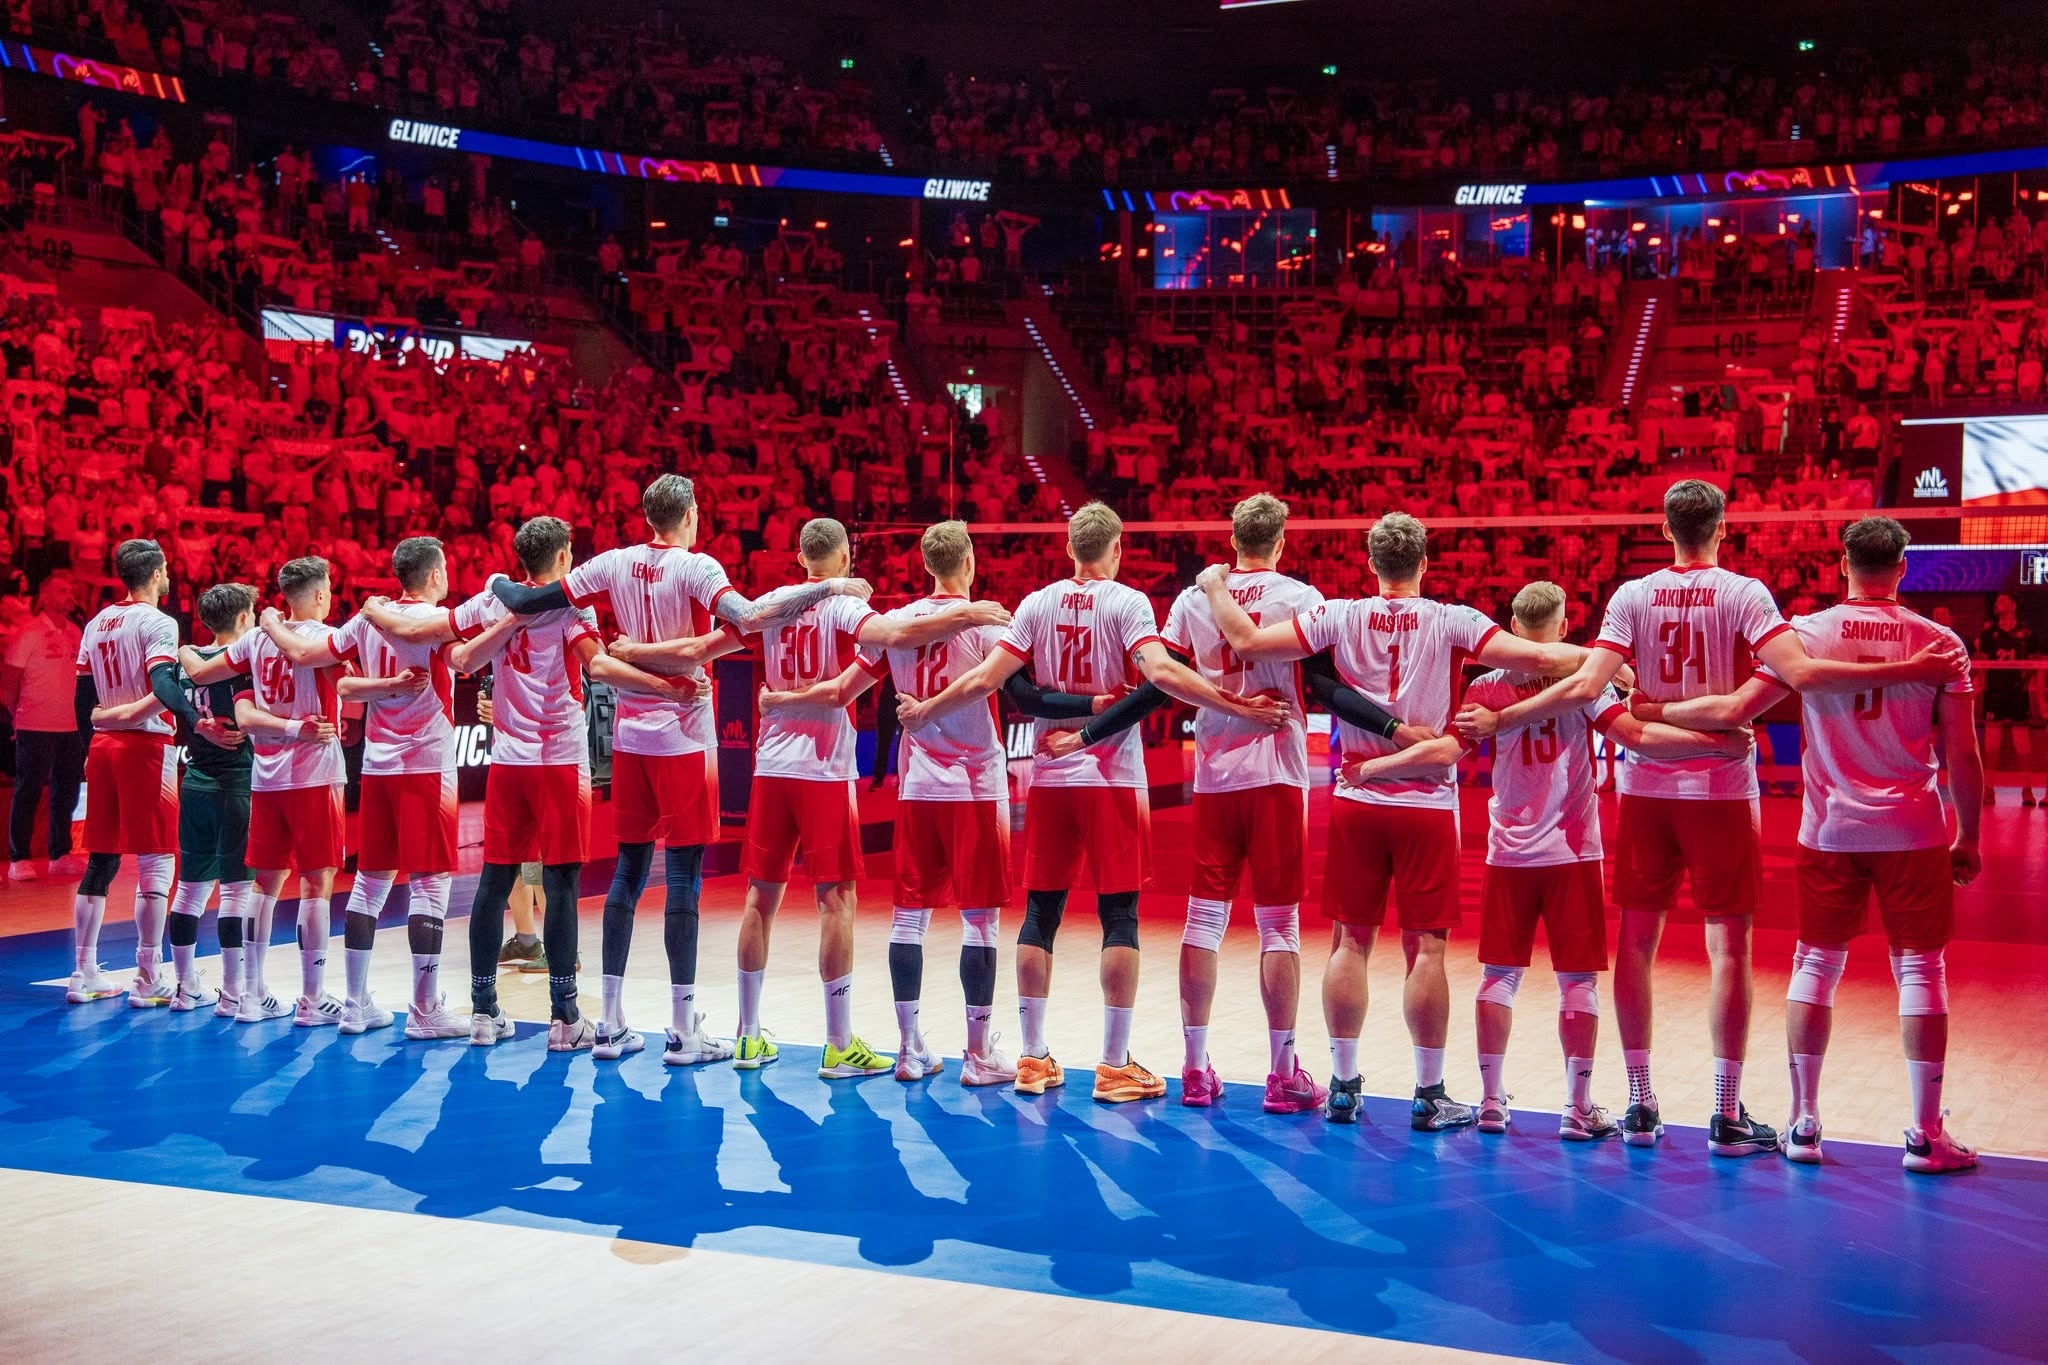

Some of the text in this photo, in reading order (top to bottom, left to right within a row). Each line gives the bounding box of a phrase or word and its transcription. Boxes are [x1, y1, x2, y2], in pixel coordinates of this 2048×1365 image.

[389, 119, 461, 149] GLIWICE
[923, 178, 992, 201] GLIWICE
[1455, 184, 1527, 205] GLIWICE
[1914, 466, 1948, 488] VNL
[780, 624, 819, 681] 30
[1056, 624, 1092, 684] 72
[1659, 621, 1707, 684] 34
[1841, 620, 1904, 642] SAWICKI
[97, 639, 122, 689] 11
[914, 640, 948, 699] 12
[1521, 718, 1557, 767] 13
